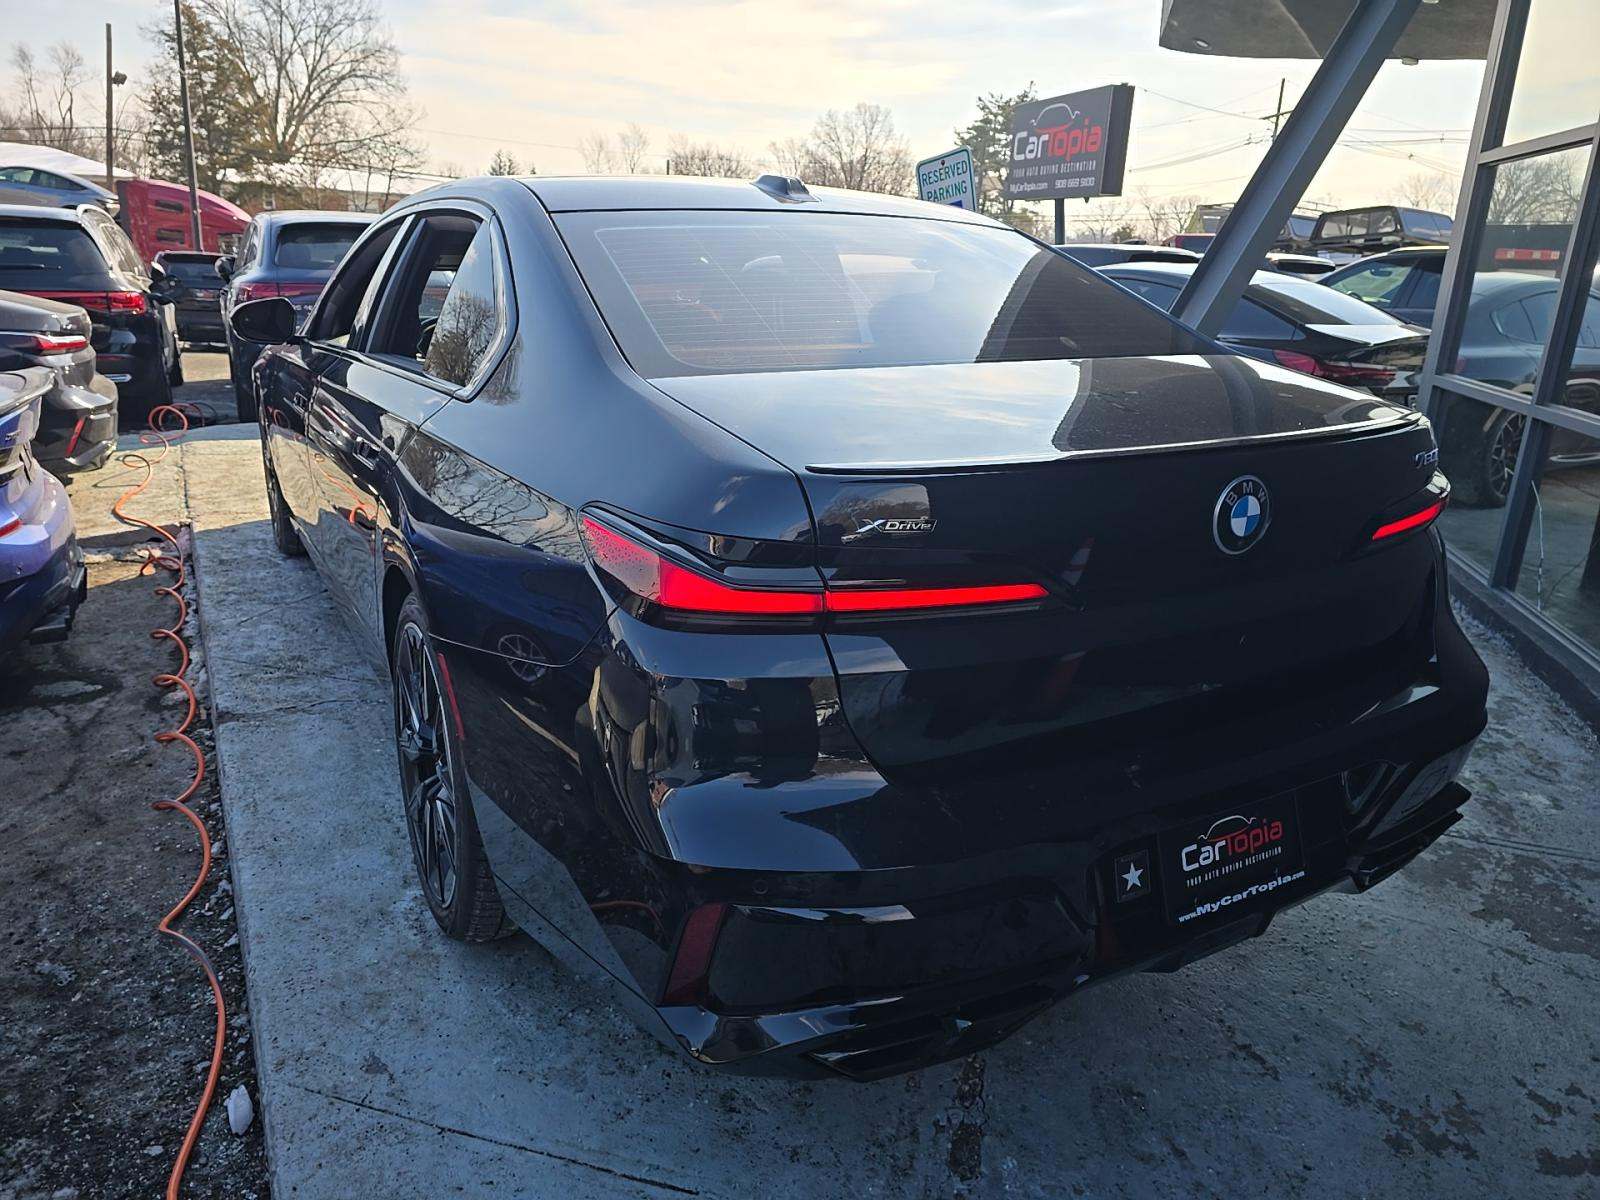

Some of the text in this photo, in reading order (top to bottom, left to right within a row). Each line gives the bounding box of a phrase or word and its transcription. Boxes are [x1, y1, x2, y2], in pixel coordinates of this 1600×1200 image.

[1013, 117, 1102, 162] CarTopia
[921, 160, 968, 187] RESERVED
[927, 180, 967, 202] PARKING
[1224, 481, 1267, 506] BMW
[1181, 819, 1283, 872] CarTopia
